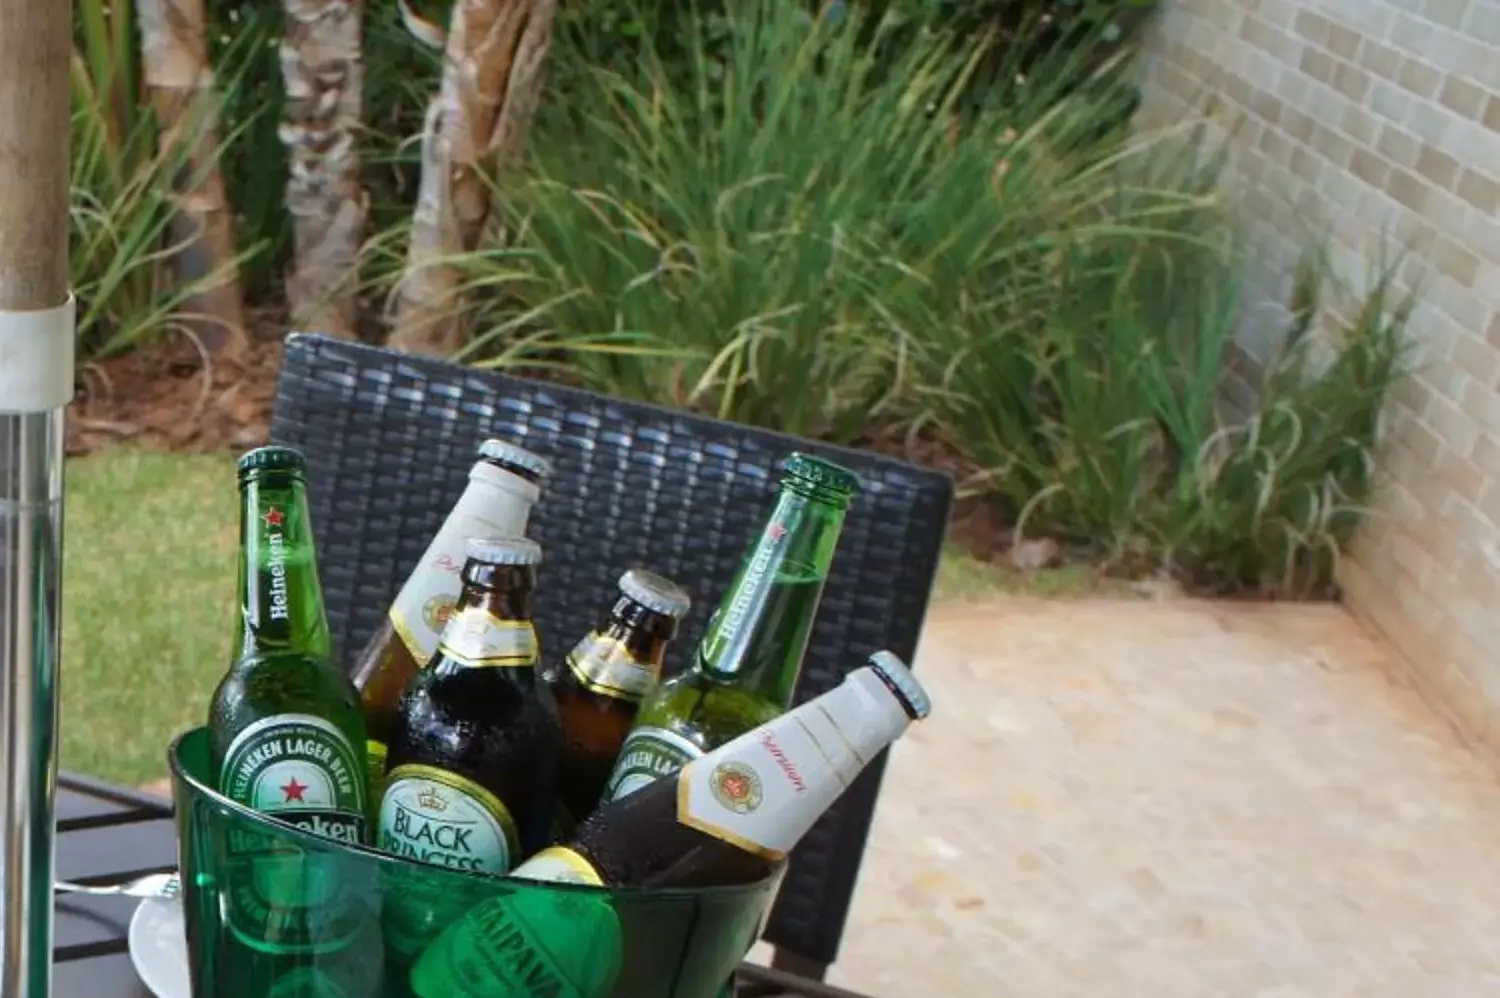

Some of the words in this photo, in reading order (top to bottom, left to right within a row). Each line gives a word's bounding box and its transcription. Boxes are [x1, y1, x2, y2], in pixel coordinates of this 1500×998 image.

[269, 532, 289, 620] Heineken
[720, 546, 774, 641] Heineken
[233, 739, 283, 799] HEINEKEN
[285, 738, 332, 763] LAGER
[329, 756, 353, 795] BEER
[394, 807, 474, 854] BLACK
